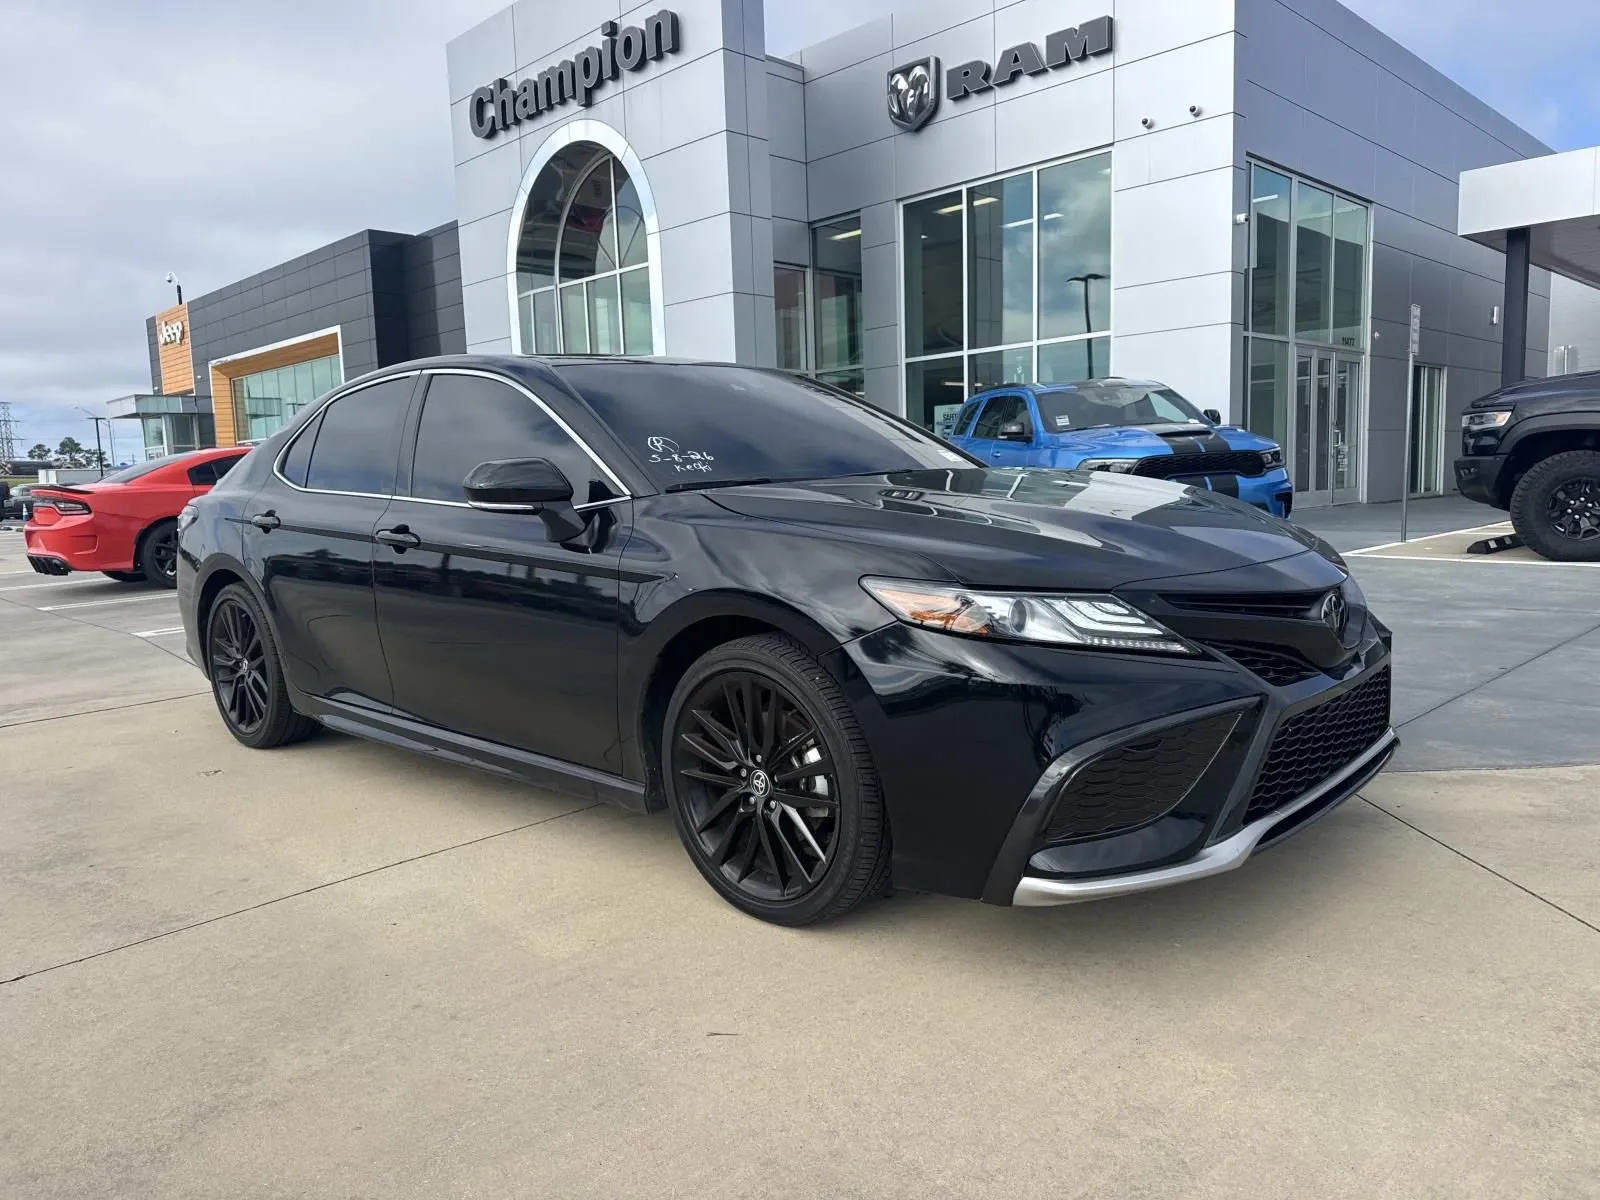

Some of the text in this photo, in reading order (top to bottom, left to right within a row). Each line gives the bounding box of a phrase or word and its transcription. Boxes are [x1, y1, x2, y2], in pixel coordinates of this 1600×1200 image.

[469, 9, 680, 139] Champion
[946, 15, 1113, 101] RAM
[160, 320, 183, 345] Jeep
